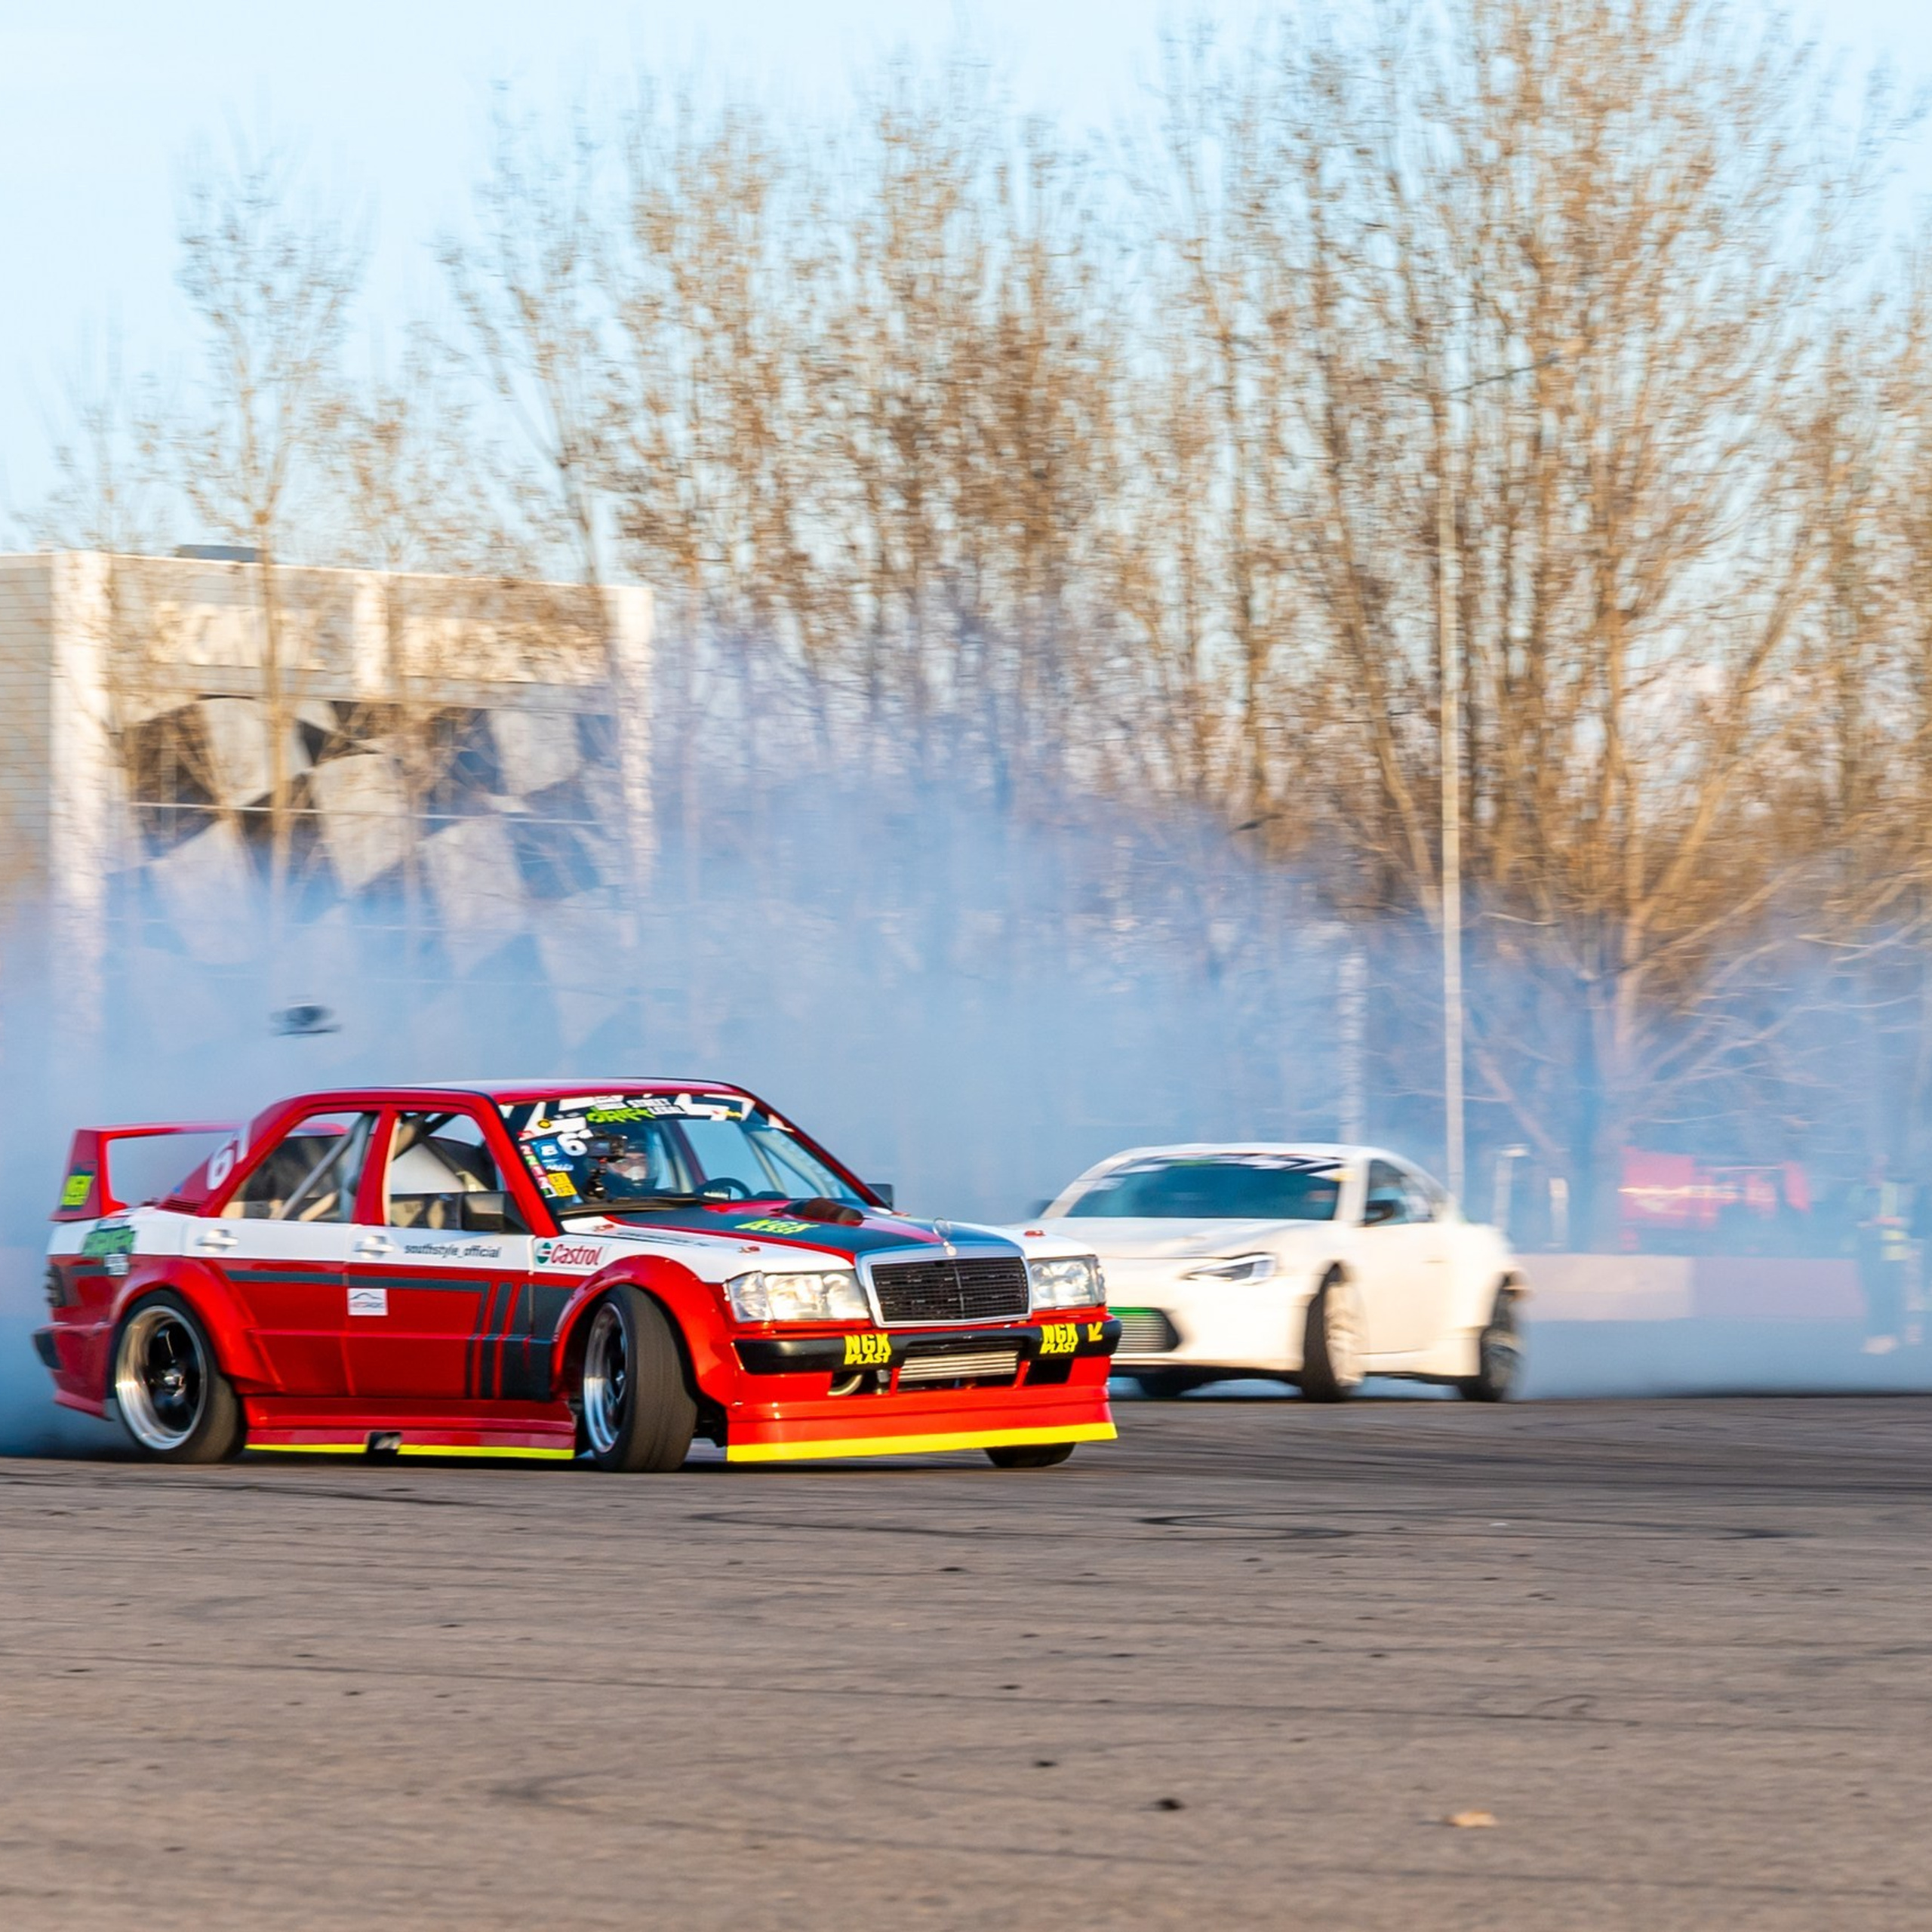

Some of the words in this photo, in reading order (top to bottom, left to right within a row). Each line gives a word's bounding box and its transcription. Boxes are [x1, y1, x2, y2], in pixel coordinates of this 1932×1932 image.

[551, 1244, 603, 1266] Castrol
[844, 1333, 892, 1355] NGK
[1041, 1323, 1078, 1345] NGK
